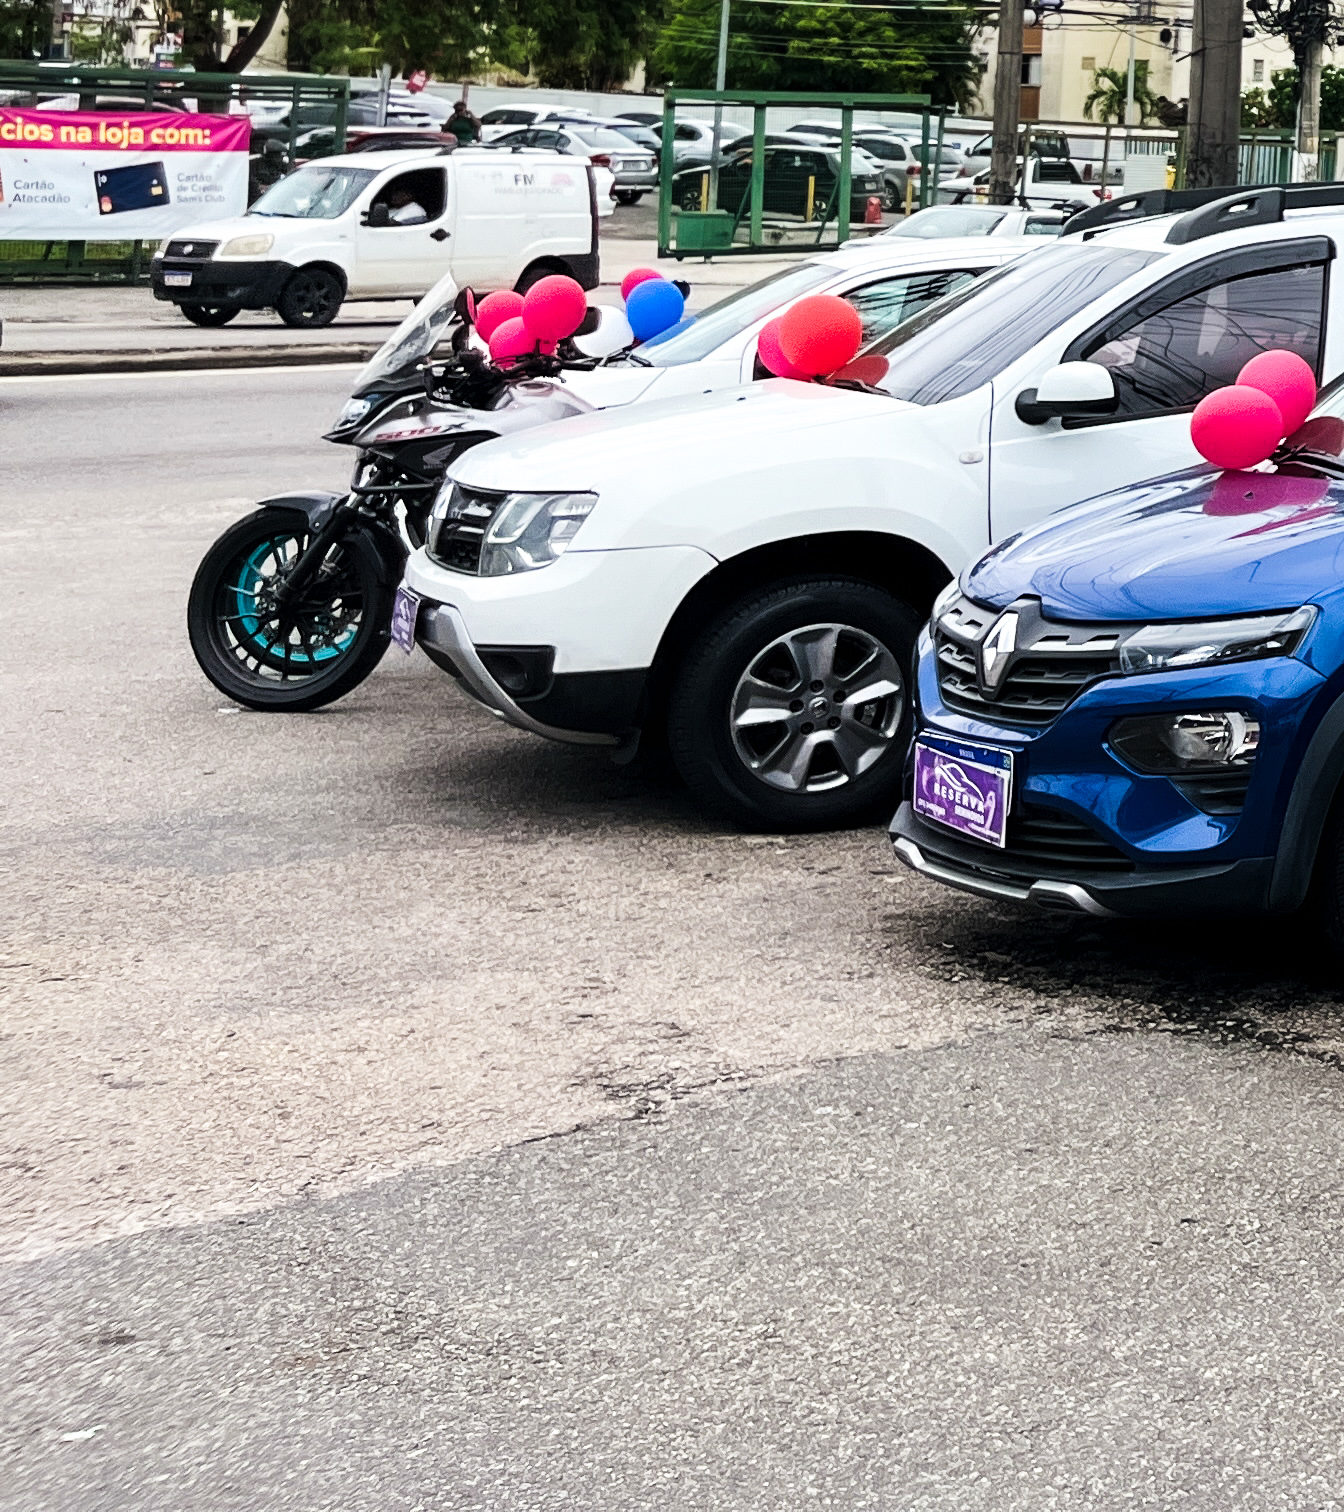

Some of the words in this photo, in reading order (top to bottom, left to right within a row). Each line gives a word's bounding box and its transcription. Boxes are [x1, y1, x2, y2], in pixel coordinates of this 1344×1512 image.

[0, 116, 54, 141] cios
[60, 125, 92, 143] na
[99, 120, 145, 149] loja
[151, 127, 211, 145] com:
[13, 179, 55, 190] Cartão
[12, 192, 71, 204] Atacadão
[933, 781, 985, 813] RESERVA
